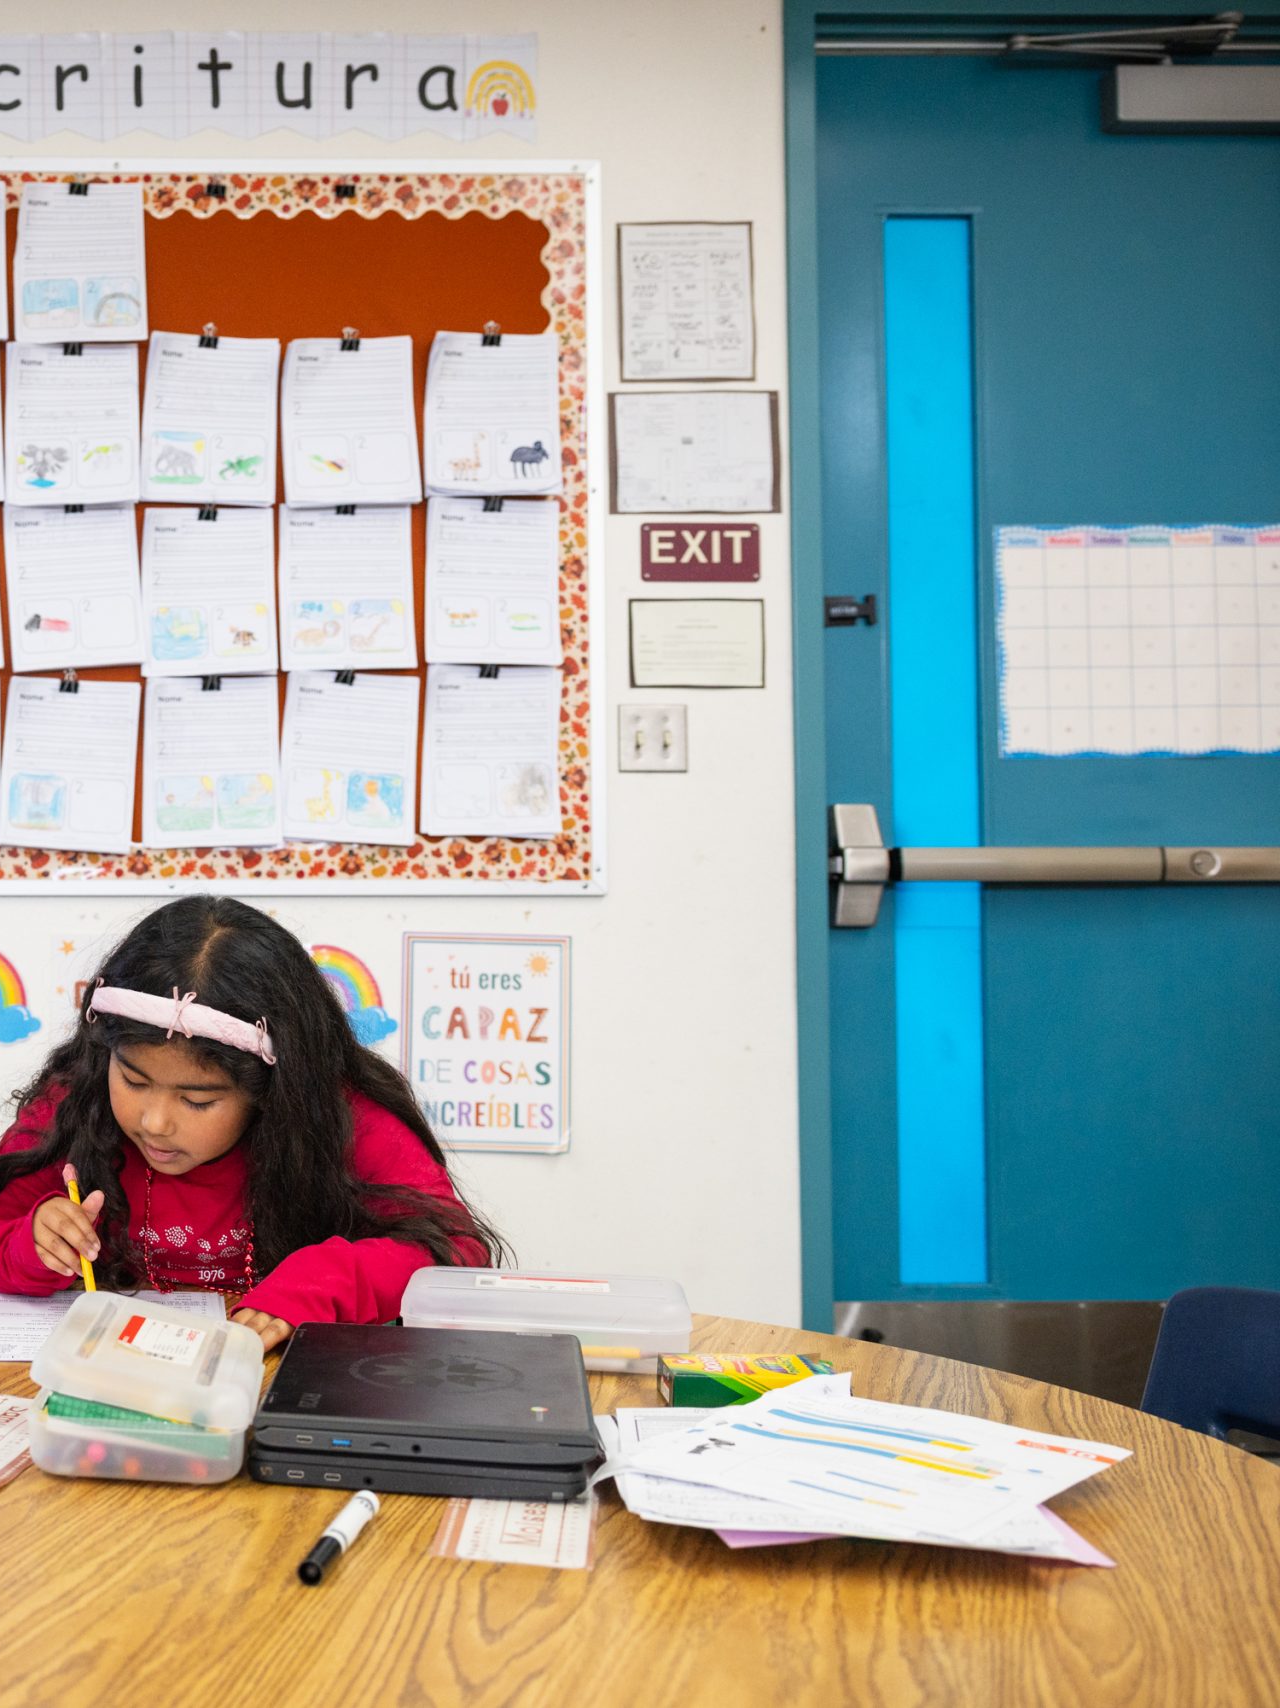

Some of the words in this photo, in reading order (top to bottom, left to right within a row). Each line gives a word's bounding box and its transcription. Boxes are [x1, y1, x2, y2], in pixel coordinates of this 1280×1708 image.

[650, 530, 752, 564] EXIT
[450, 966, 470, 989] tú
[478, 972, 522, 990] eres
[422, 1006, 549, 1043] CAPAZ
[419, 1059, 452, 1084] DE
[464, 1060, 551, 1086] COSAS
[424, 1094, 554, 1129] NCREÍBLES
[198, 1268, 225, 1282] 1976
